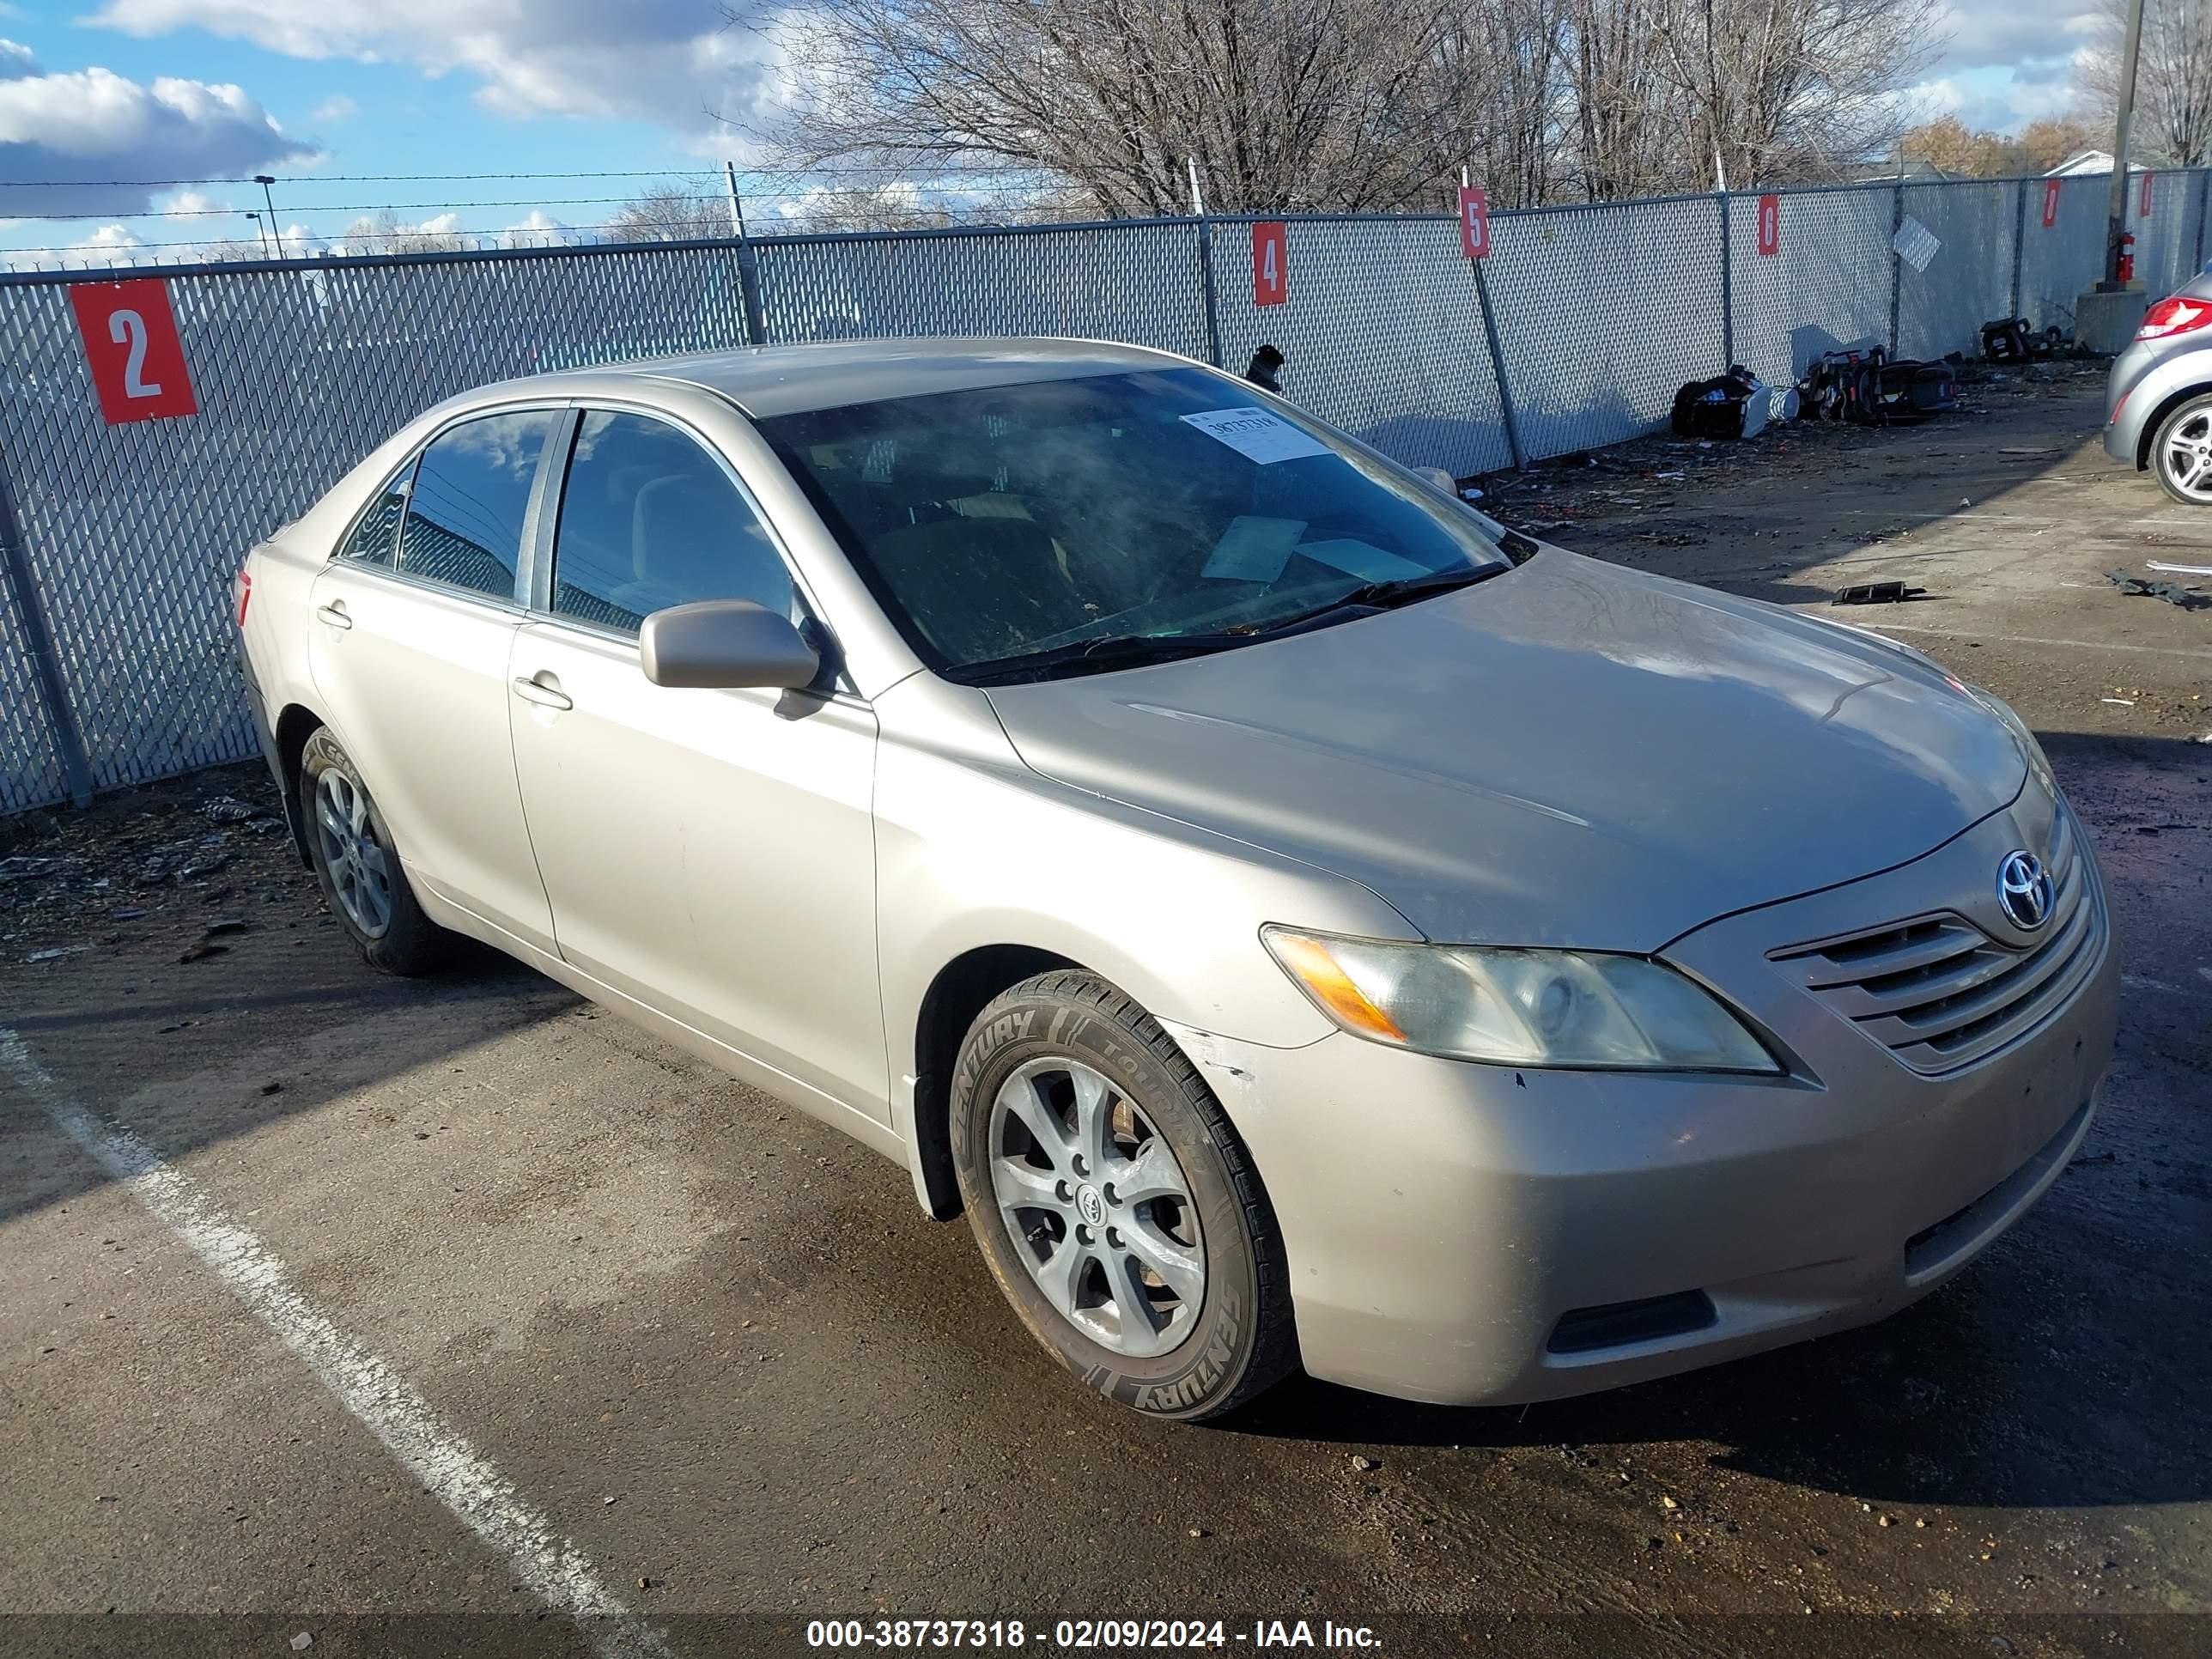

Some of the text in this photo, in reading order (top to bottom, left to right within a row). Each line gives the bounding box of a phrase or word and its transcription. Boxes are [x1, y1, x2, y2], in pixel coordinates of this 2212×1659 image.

[1468, 202, 1482, 247] 5
[1765, 206, 1774, 246] 6
[1263, 239, 1279, 292] 4
[108, 309, 162, 399] 2
[1207, 417, 1279, 434] 38737318
[1132, 1278, 1242, 1411] SENTURY
